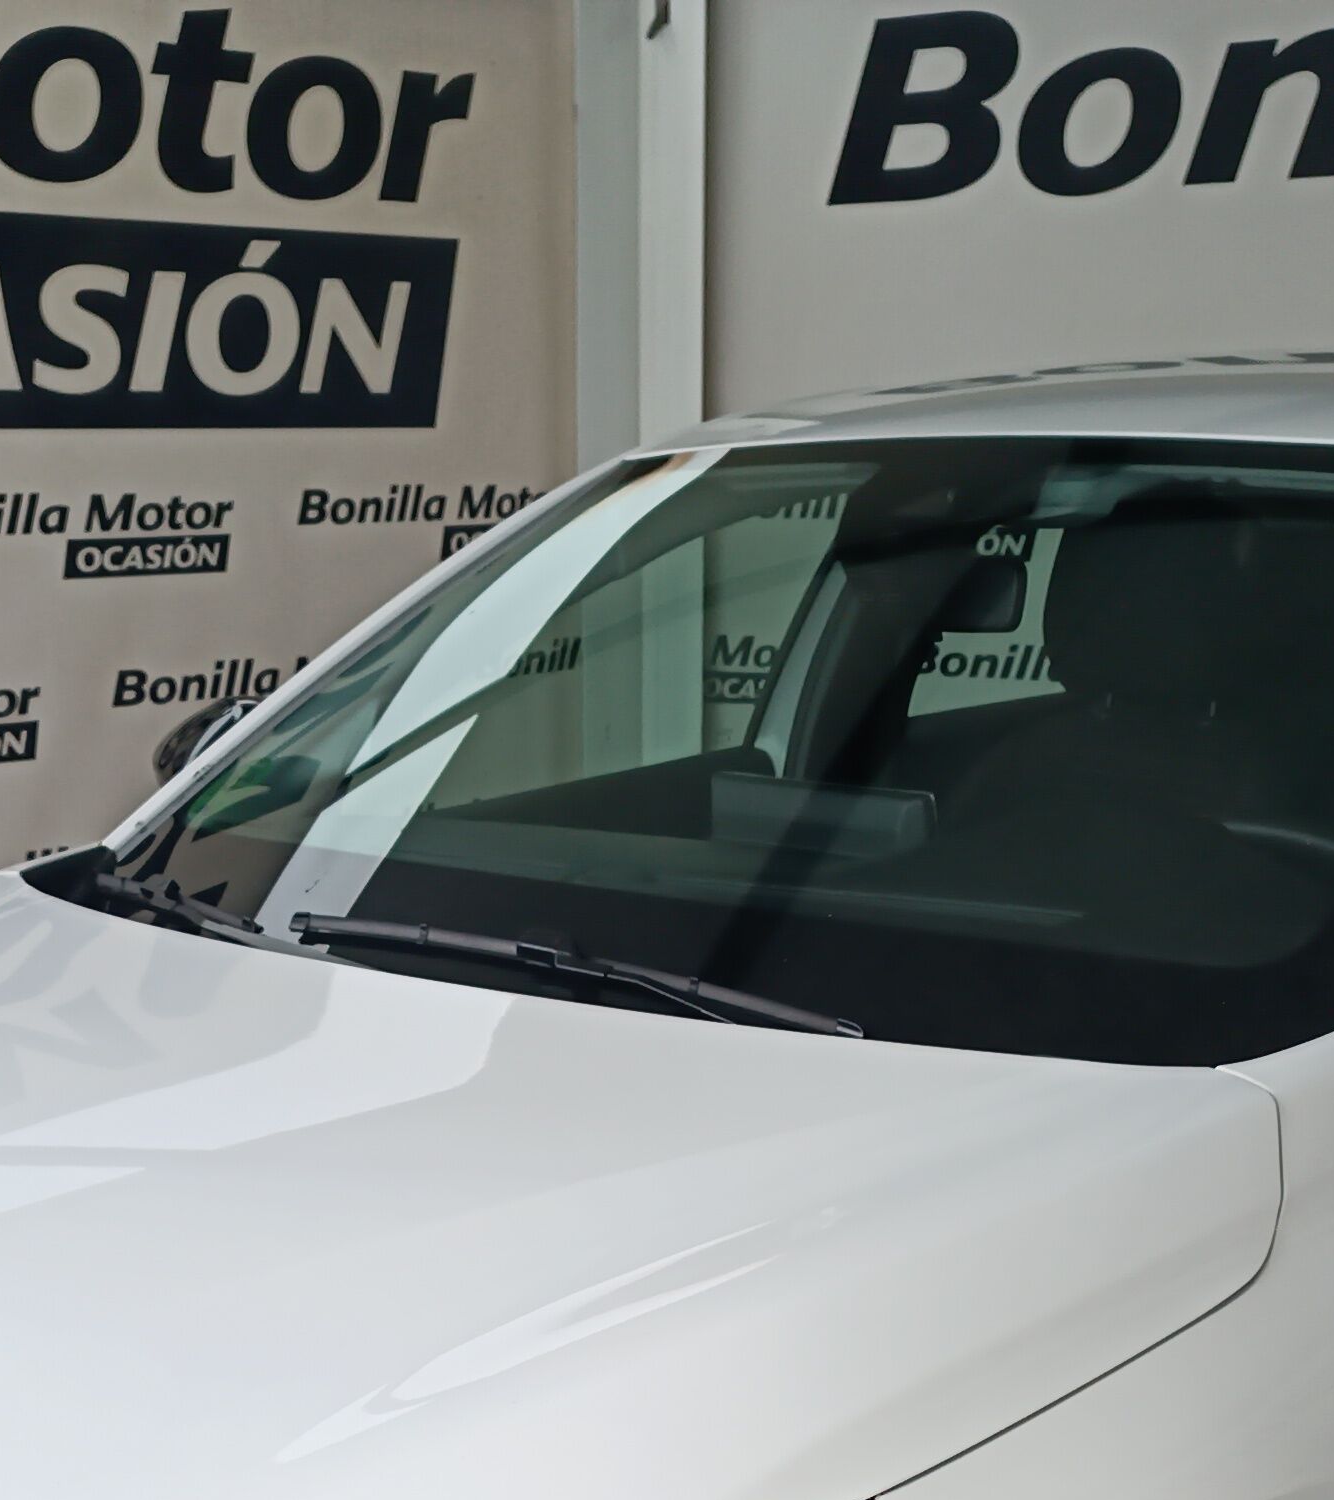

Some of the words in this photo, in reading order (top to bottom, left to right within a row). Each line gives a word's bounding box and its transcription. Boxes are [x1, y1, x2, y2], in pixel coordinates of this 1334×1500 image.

[85, 493, 234, 533] Motor
[298, 484, 447, 525] Bonilla
[75, 537, 221, 574] OCASIÓN
[112, 658, 280, 707] Bonilla
